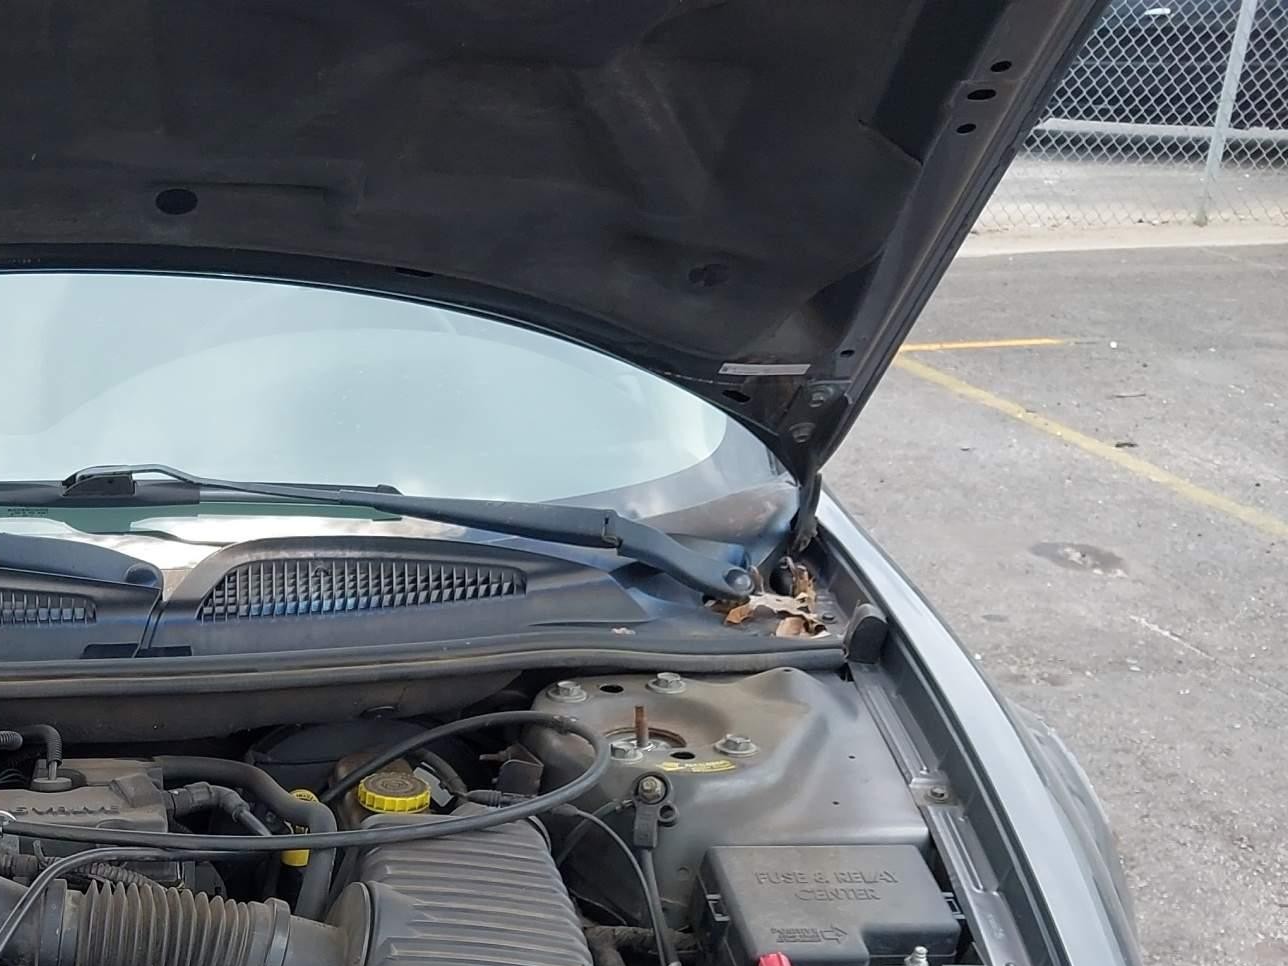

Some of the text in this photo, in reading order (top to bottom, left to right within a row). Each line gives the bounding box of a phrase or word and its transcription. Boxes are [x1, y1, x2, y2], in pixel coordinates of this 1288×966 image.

[754, 870, 899, 885] FUSE & RELAY
[794, 887, 881, 901] CENTER
